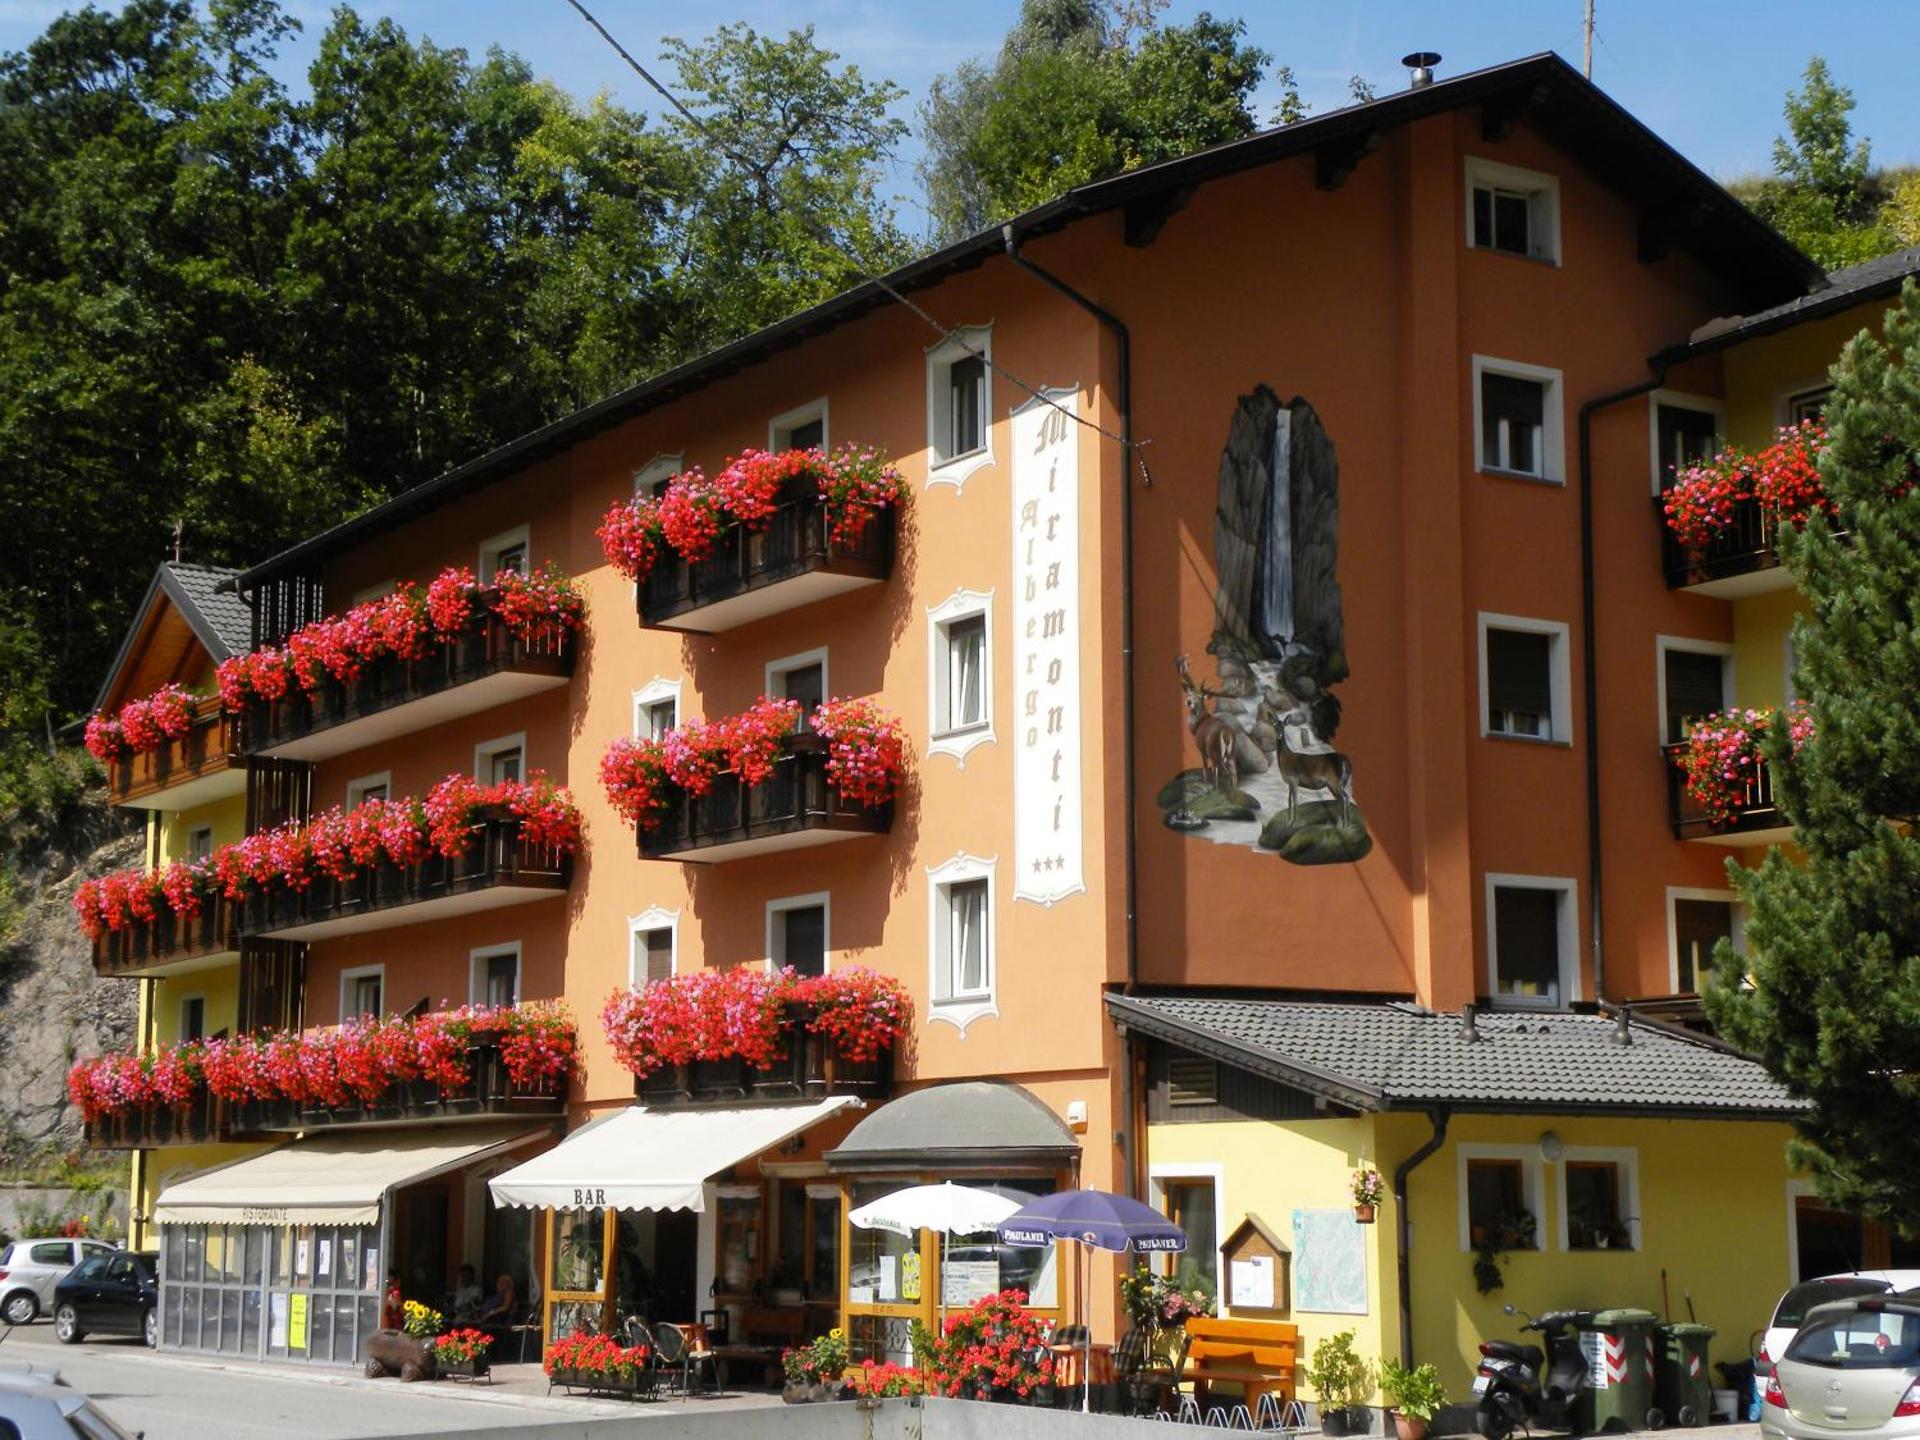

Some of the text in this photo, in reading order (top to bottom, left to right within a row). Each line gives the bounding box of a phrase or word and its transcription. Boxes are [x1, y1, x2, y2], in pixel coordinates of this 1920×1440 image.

[1019, 498, 1040, 748] Albergo
[1034, 404, 1069, 832] Miramonti
[574, 1188, 606, 1205] BAR
[1003, 1229, 1045, 1243] PAULANER
